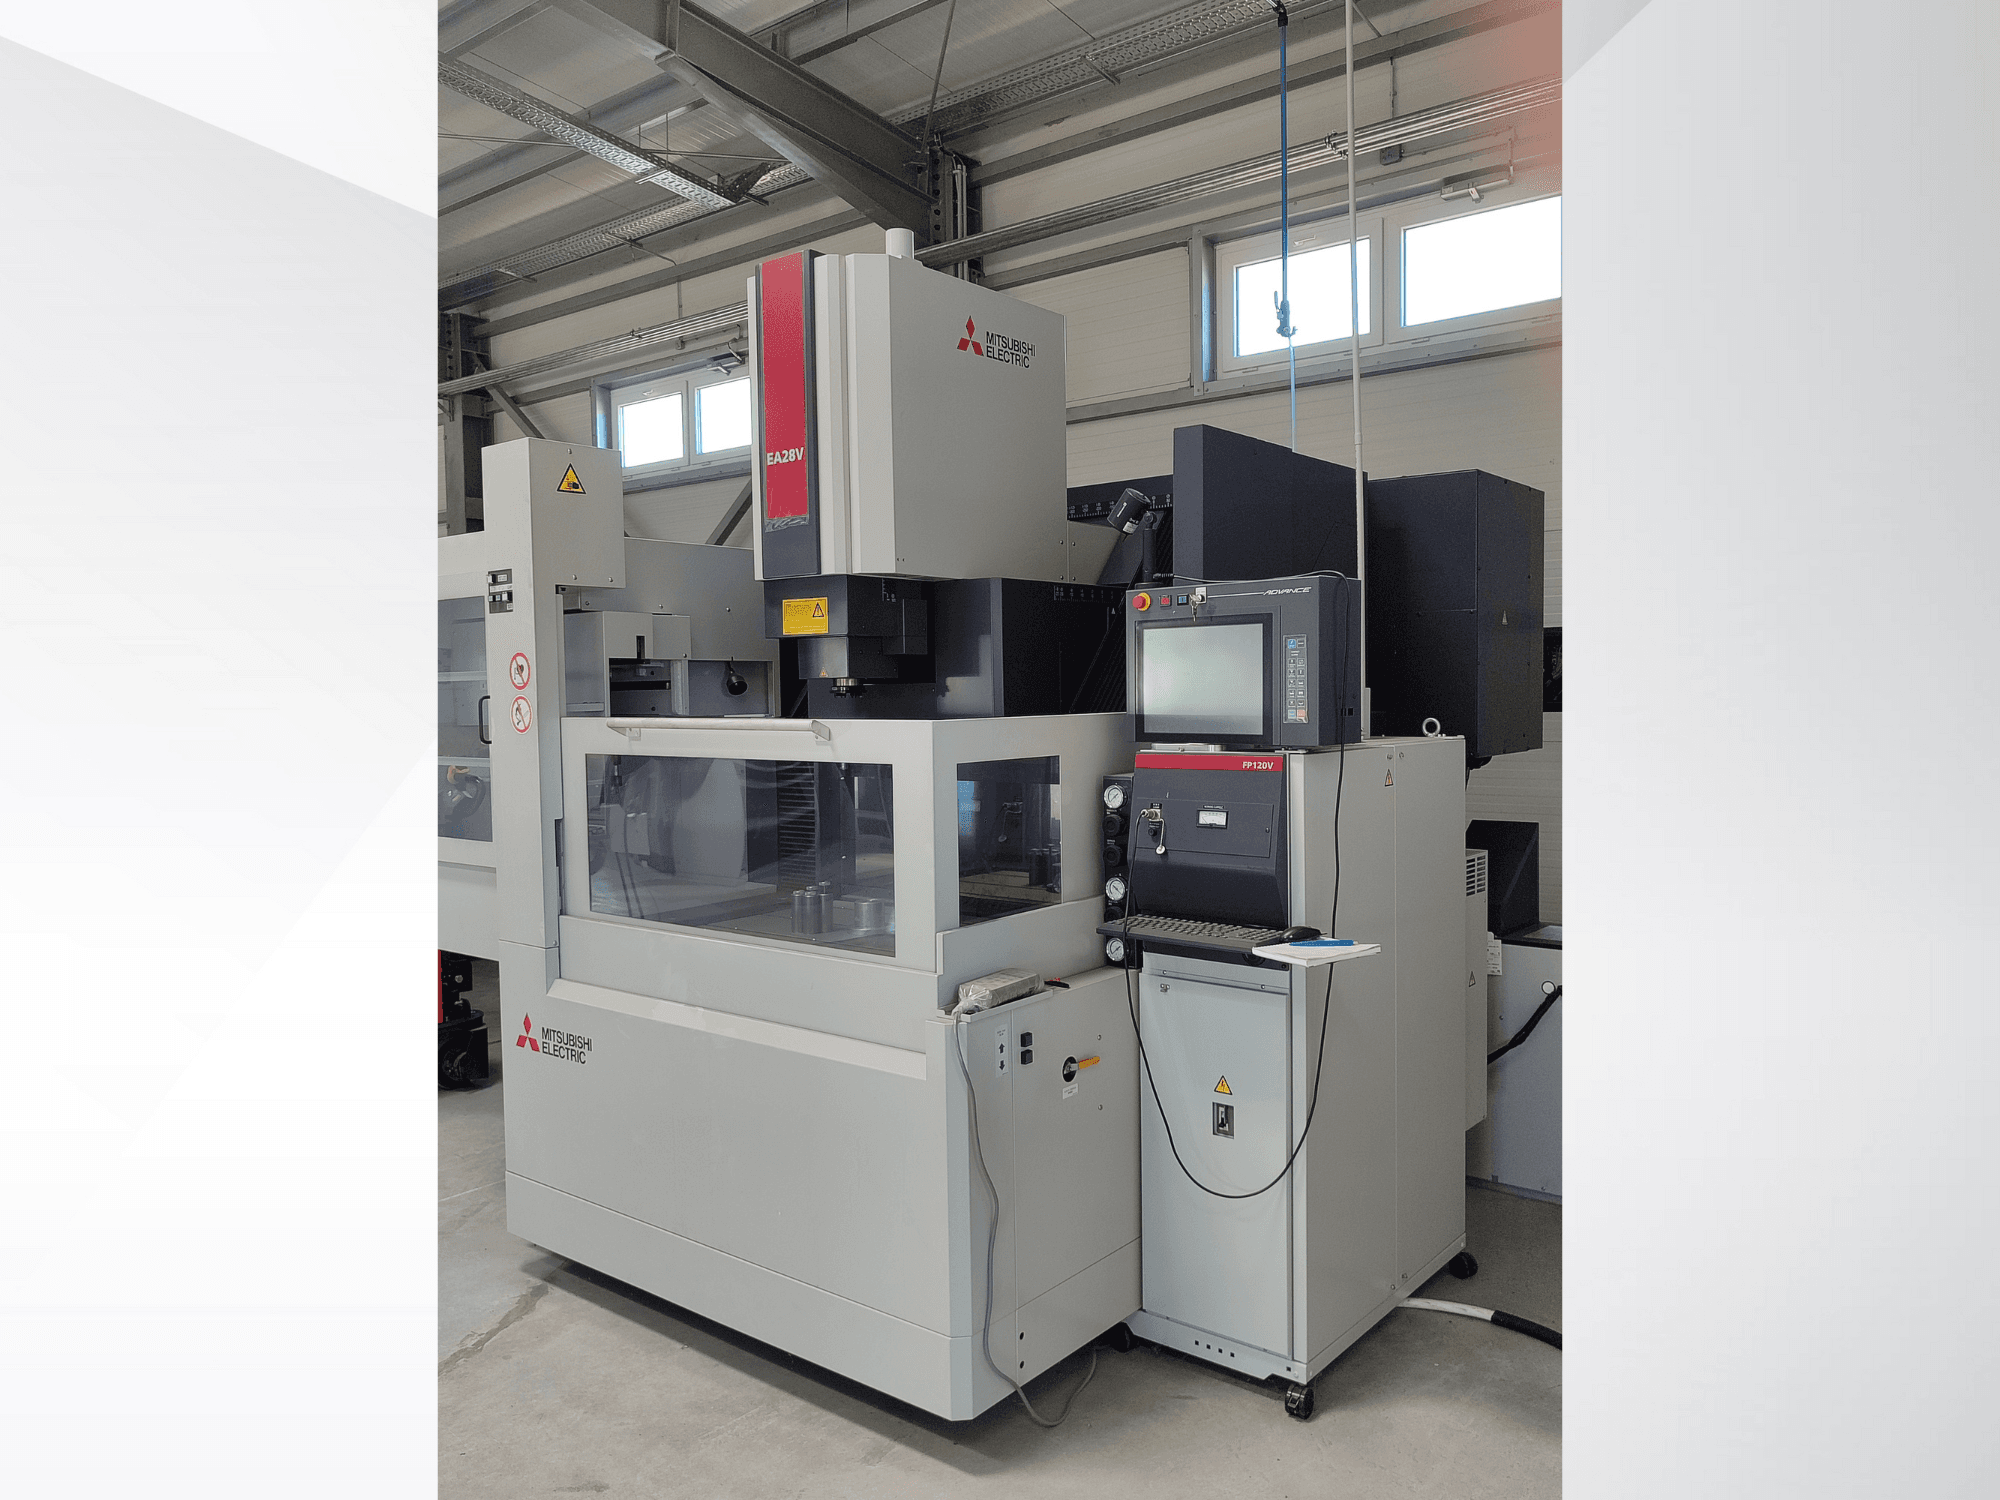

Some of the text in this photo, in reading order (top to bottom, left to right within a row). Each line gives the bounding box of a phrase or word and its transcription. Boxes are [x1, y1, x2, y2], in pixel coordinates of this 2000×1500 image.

[986, 330, 1036, 357] MITSUBISHI
[986, 345, 1030, 369] ELECTRIC
[766, 446, 804, 466] EA28V
[1263, 586, 1312, 596] ADVANCE
[1242, 761, 1274, 770] FP120V
[541, 1026, 593, 1052] MITSUBISHI
[541, 1040, 587, 1065] ELECTRIC
